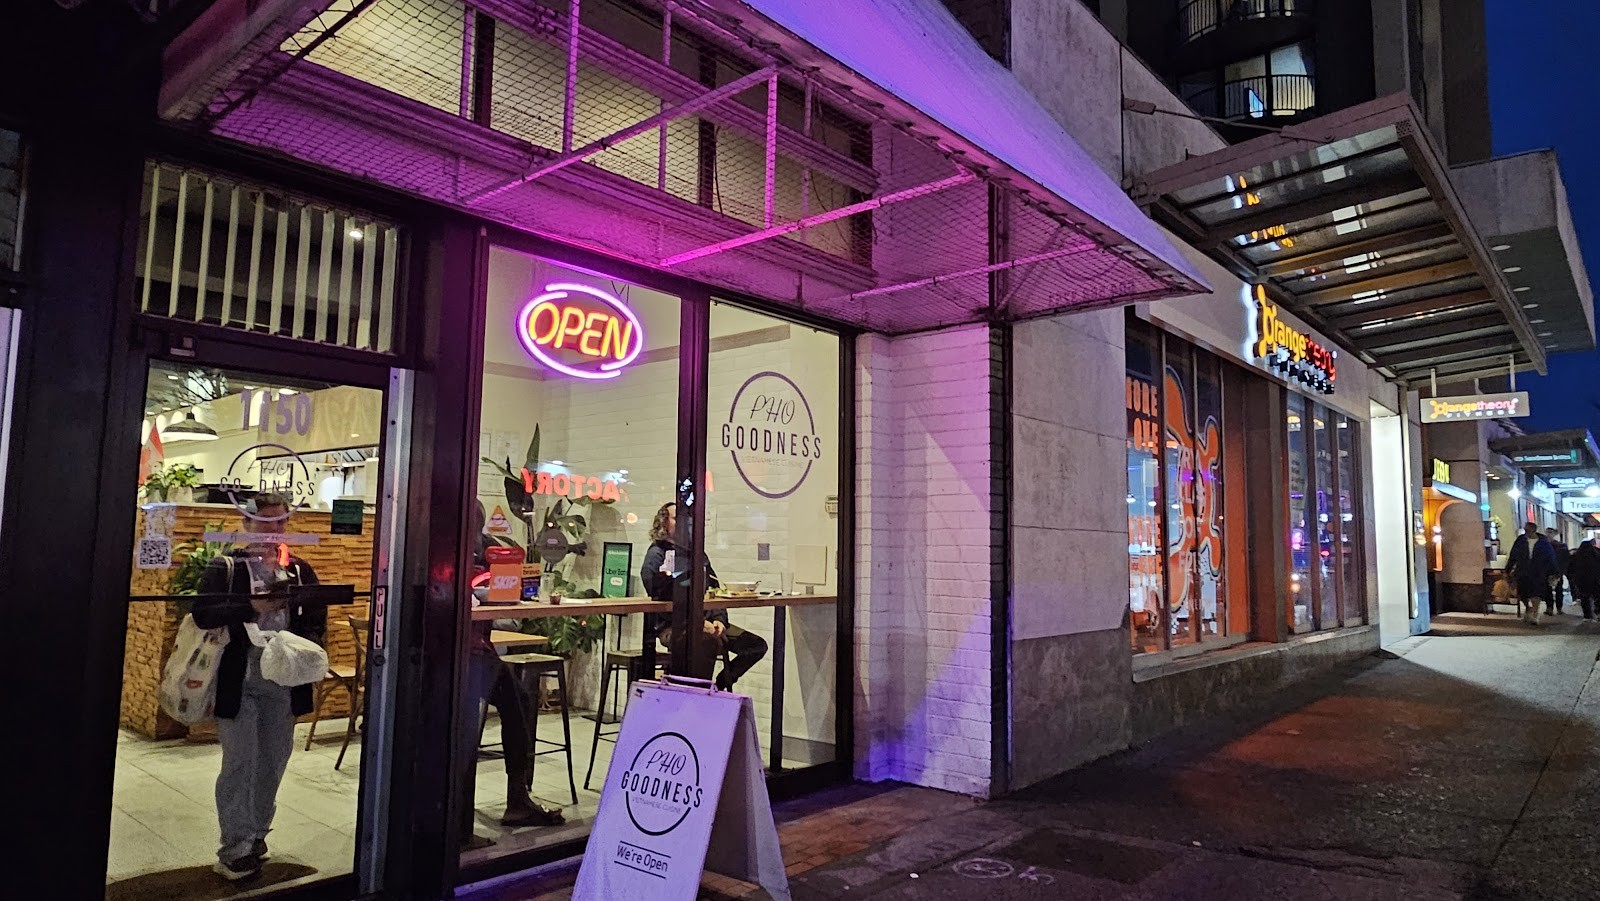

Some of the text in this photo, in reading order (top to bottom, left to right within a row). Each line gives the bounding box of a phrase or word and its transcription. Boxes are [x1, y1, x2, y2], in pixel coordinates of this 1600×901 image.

[528, 302, 632, 360] OPEN
[241, 389, 313, 436] 1150
[750, 394, 796, 425] PHO
[721, 423, 821, 459] GOODNESS
[220, 476, 315, 497] GODNESS
[1570, 501, 1600, 509] Trees
[492, 575, 519, 590] SKIP
[374, 588, 384, 649] PULL
[645, 749, 687, 776] PHO
[621, 770, 703, 808] GOODNESS
[617, 845, 668, 872] We're Open
